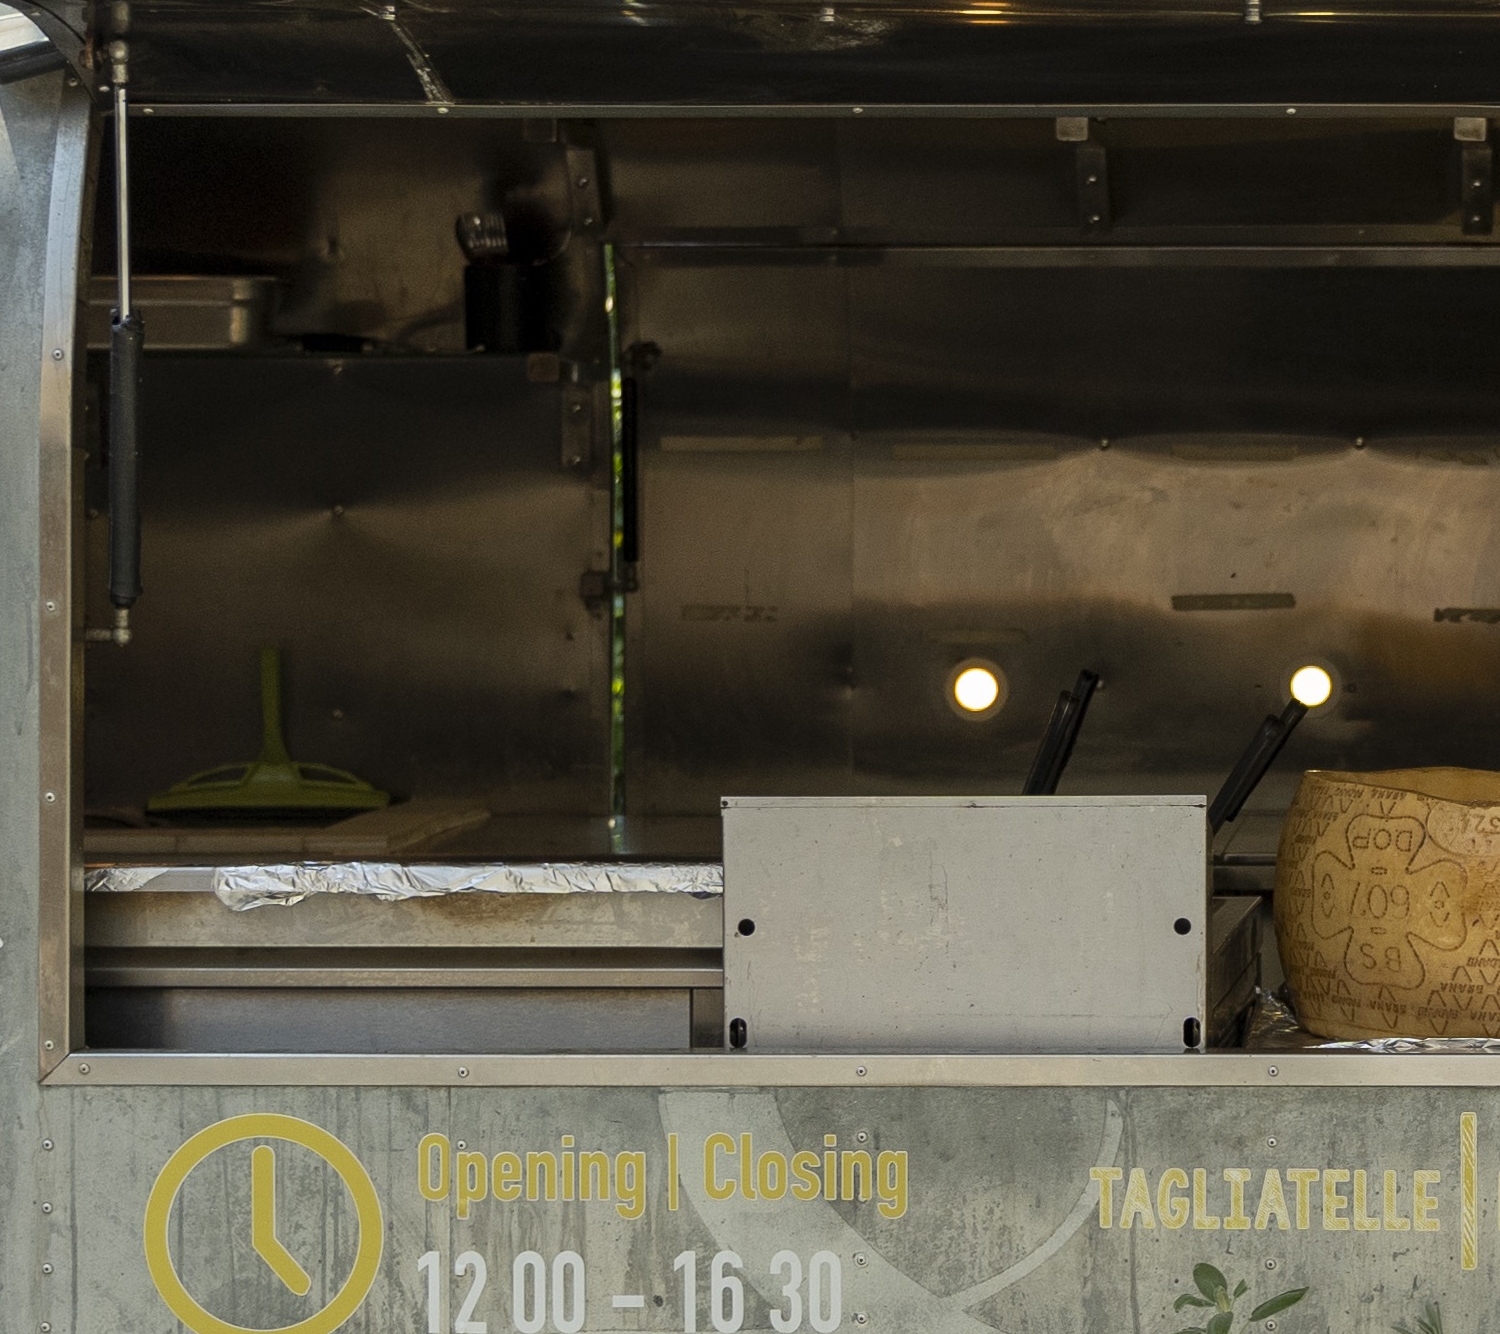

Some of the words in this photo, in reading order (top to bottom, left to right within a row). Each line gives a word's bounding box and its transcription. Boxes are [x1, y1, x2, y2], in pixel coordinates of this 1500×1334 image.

[416, 1133, 646, 1220] Opening
[704, 1133, 909, 1220] Closing
[1090, 1167, 1442, 1231] TAGLIATELLE
[418, 1250, 488, 1334] 12
[511, 1250, 586, 1334] 00
[672, 1250, 744, 1333] 16
[769, 1250, 843, 1333] 30
